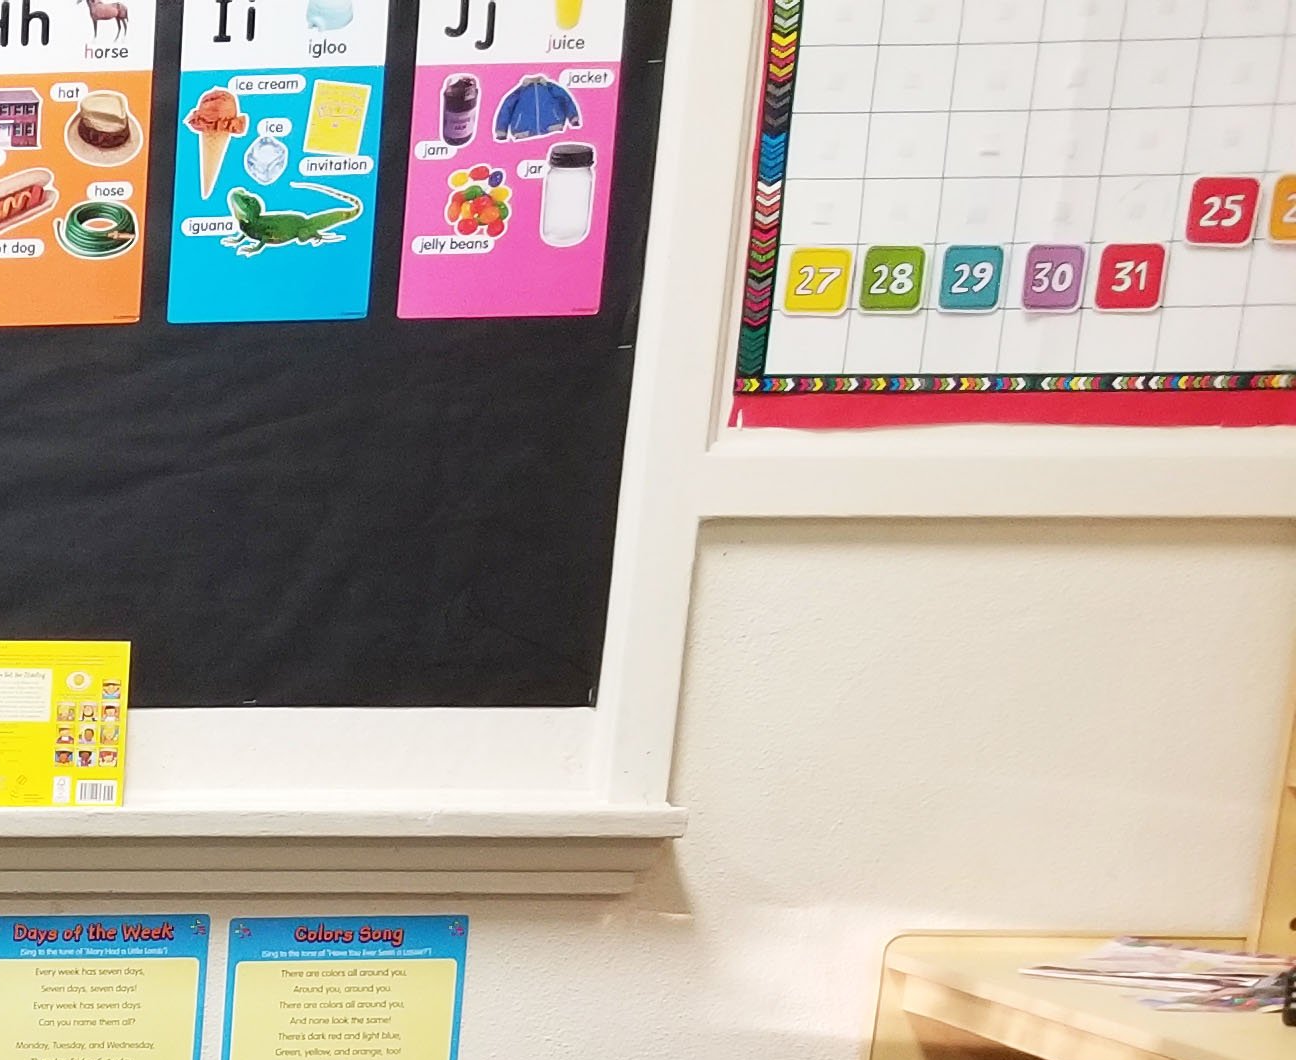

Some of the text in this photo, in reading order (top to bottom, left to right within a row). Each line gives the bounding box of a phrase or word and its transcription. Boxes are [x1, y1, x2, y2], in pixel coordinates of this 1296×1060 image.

[85, 44, 128, 59] horse
[309, 39, 346, 58] igloo
[546, 35, 584, 53] juice
[235, 78, 298, 92] ice cream
[566, 71, 608, 86] jacket
[58, 87, 79, 98] hat
[265, 120, 285, 134] ice
[422, 144, 449, 158] jam
[305, 156, 368, 173] invitation
[523, 162, 544, 177] jar
[94, 183, 125, 198] hose
[1198, 194, 1246, 228] 25
[188, 218, 234, 234] iguana
[10, 240, 37, 257] dog
[419, 237, 489, 253] jelly beans
[793, 266, 842, 297] 27
[868, 262, 915, 297] 28
[949, 260, 995, 296] 29
[1030, 261, 1076, 295] 30
[1110, 259, 1149, 294] 31
[13, 920, 175, 946] Days of the Week
[294, 921, 405, 948] Colors Song
